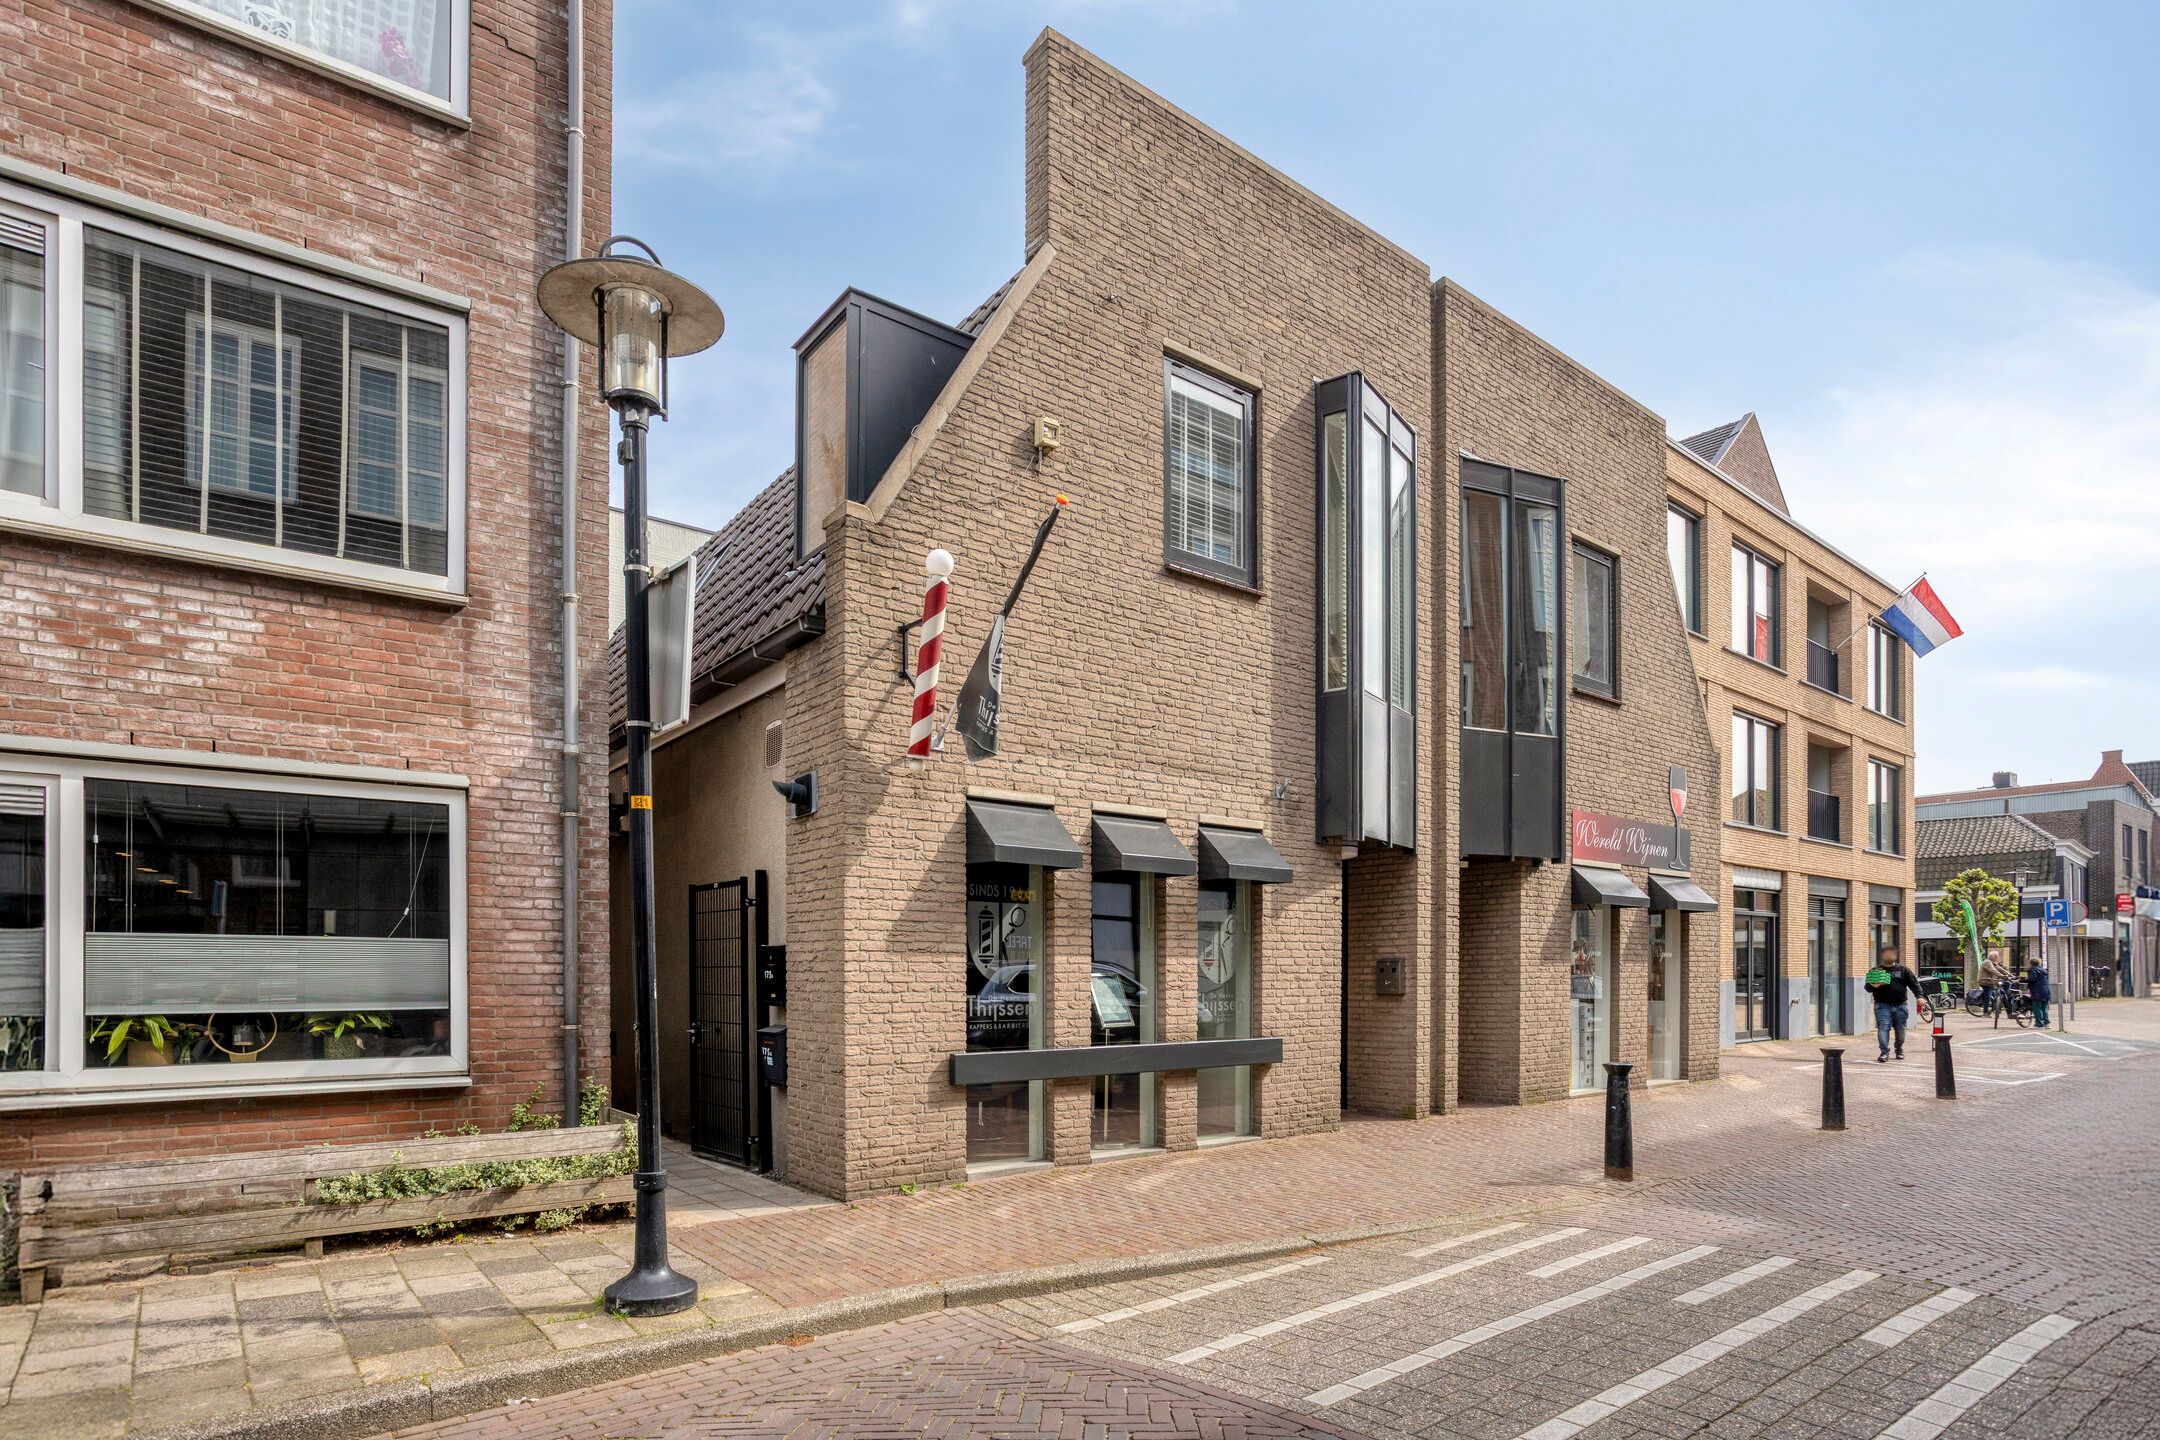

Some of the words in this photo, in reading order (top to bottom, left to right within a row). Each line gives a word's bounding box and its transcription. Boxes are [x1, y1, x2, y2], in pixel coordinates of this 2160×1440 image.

[1576, 819, 1625, 851] Wereld
[1626, 827, 1669, 865] Wijnen
[969, 883, 999, 898] SINDS
[2050, 902, 2064, 917] P
[967, 995, 1034, 1022] Thijssen
